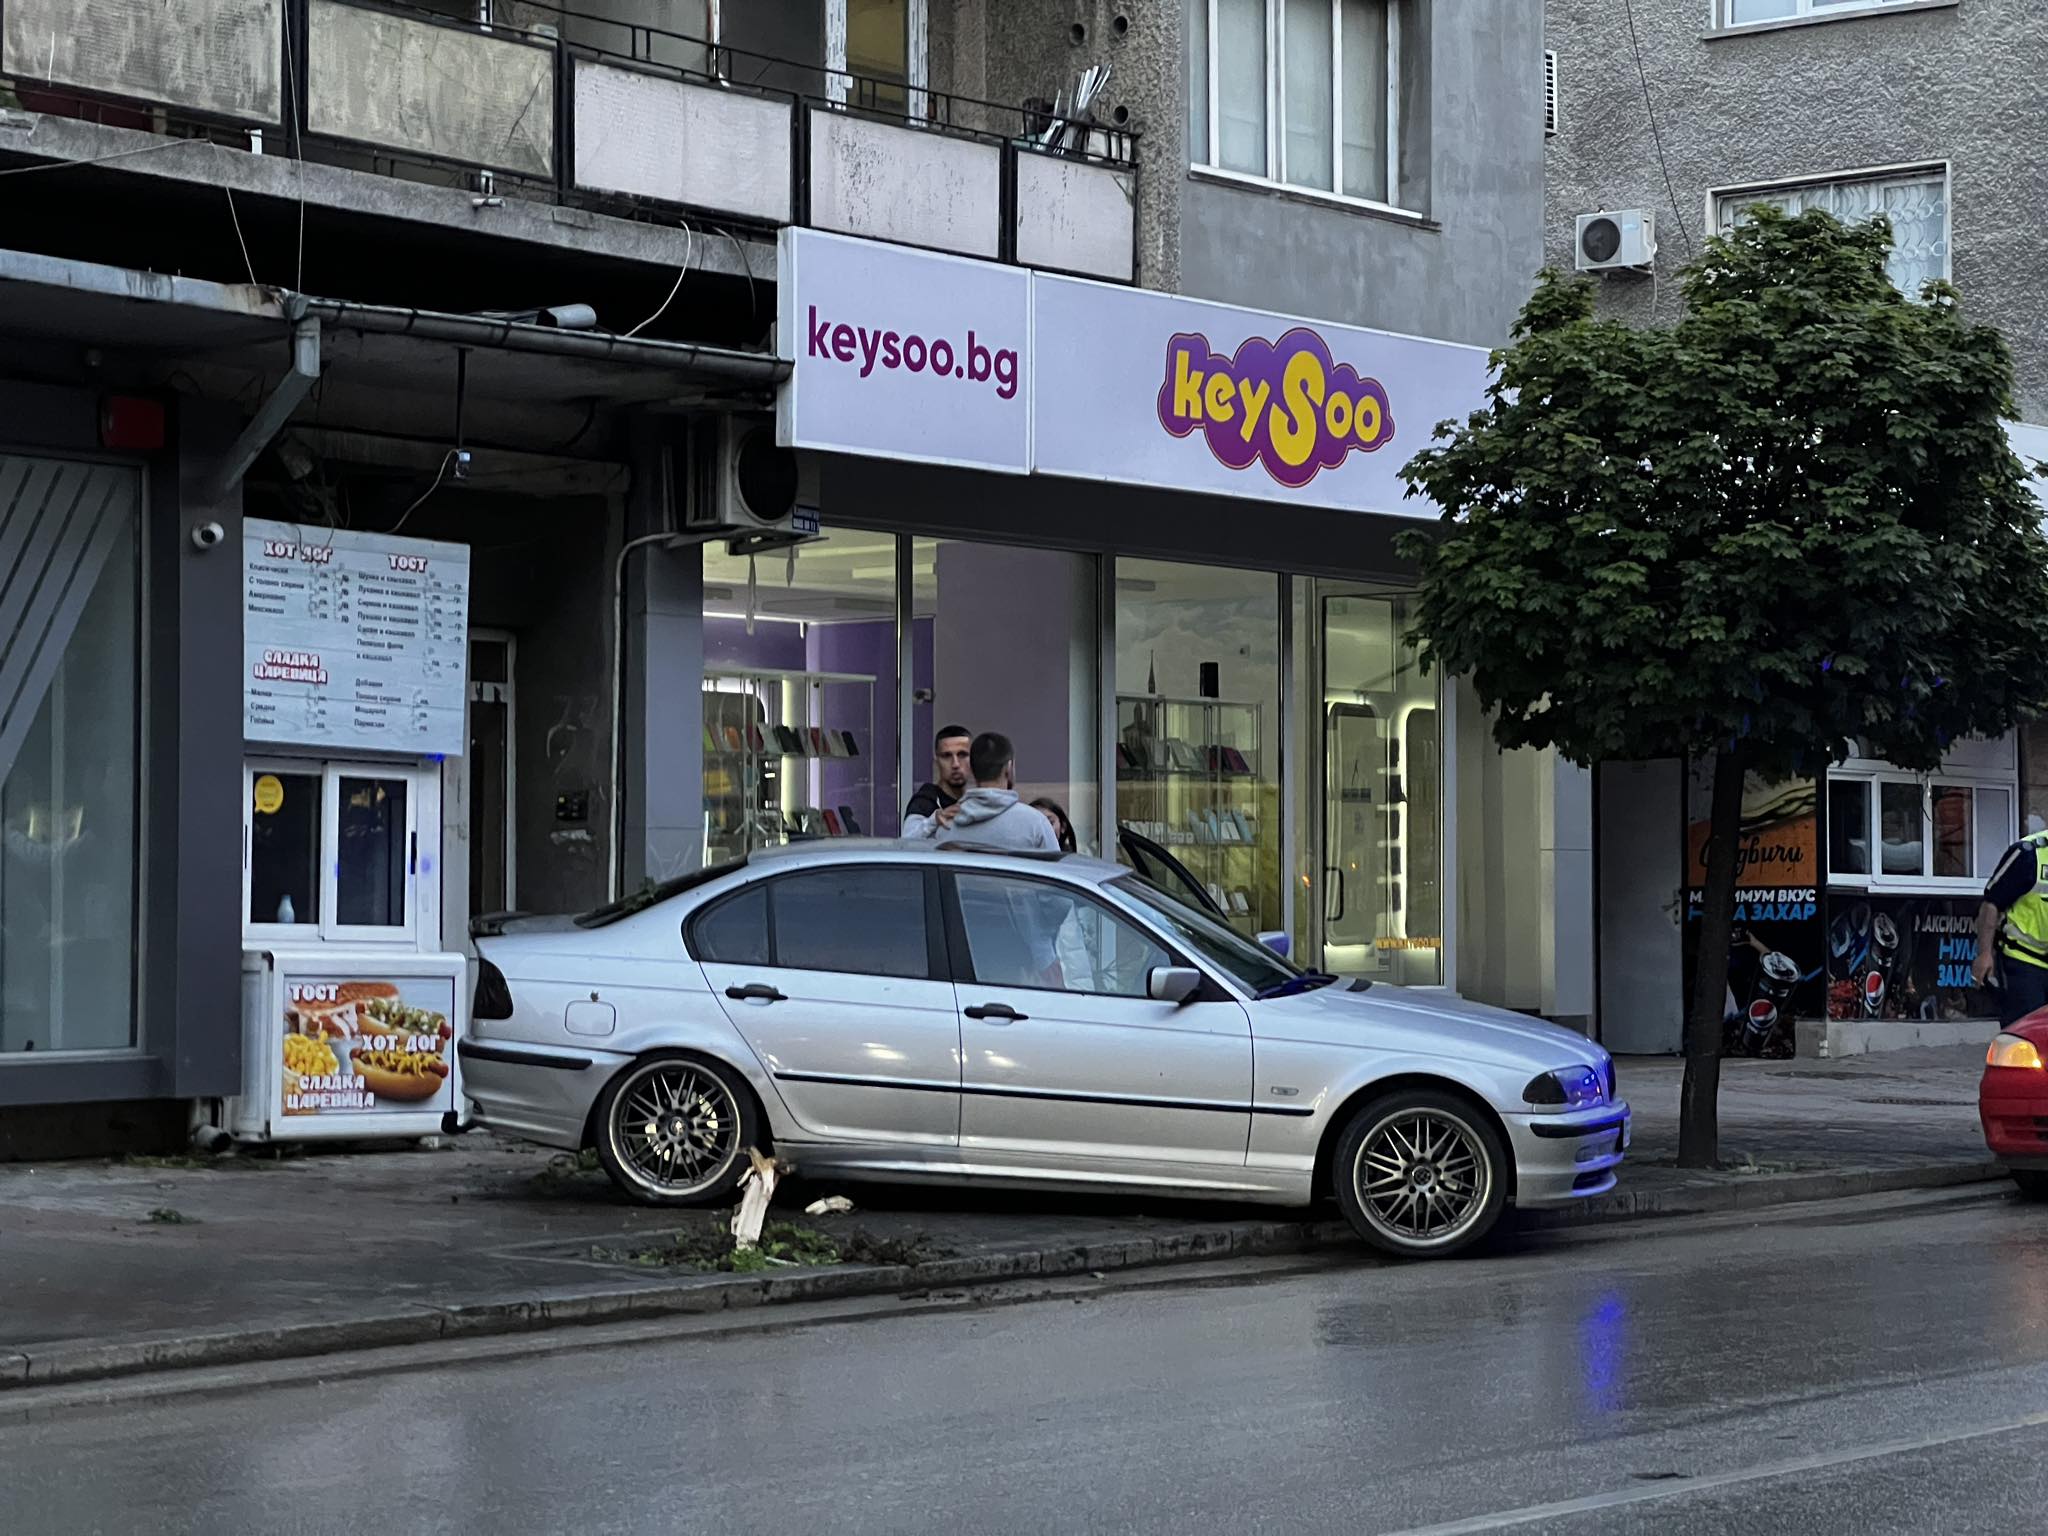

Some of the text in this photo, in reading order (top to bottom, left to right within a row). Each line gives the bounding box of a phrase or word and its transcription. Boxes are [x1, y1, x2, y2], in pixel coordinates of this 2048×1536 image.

[808, 304, 1019, 400] keysoo.bg
[264, 540, 333, 563] ХОТ ДОГ
[388, 554, 428, 573] ТОСТ
[263, 649, 320, 669] СЛАДКА
[253, 663, 328, 685] ЦАРЕВИЦА
[1777, 888, 1816, 903] ВКУС
[1750, 903, 1817, 921] ЗАХАР
[1937, 964, 1976, 988] ЗАХА
[289, 983, 339, 1002] ТОСТ
[361, 1034, 441, 1052] ХОТ ДОГ
[298, 1074, 366, 1090] СЛАДКА
[286, 1091, 376, 1110] ЦАРЕВИЦА
